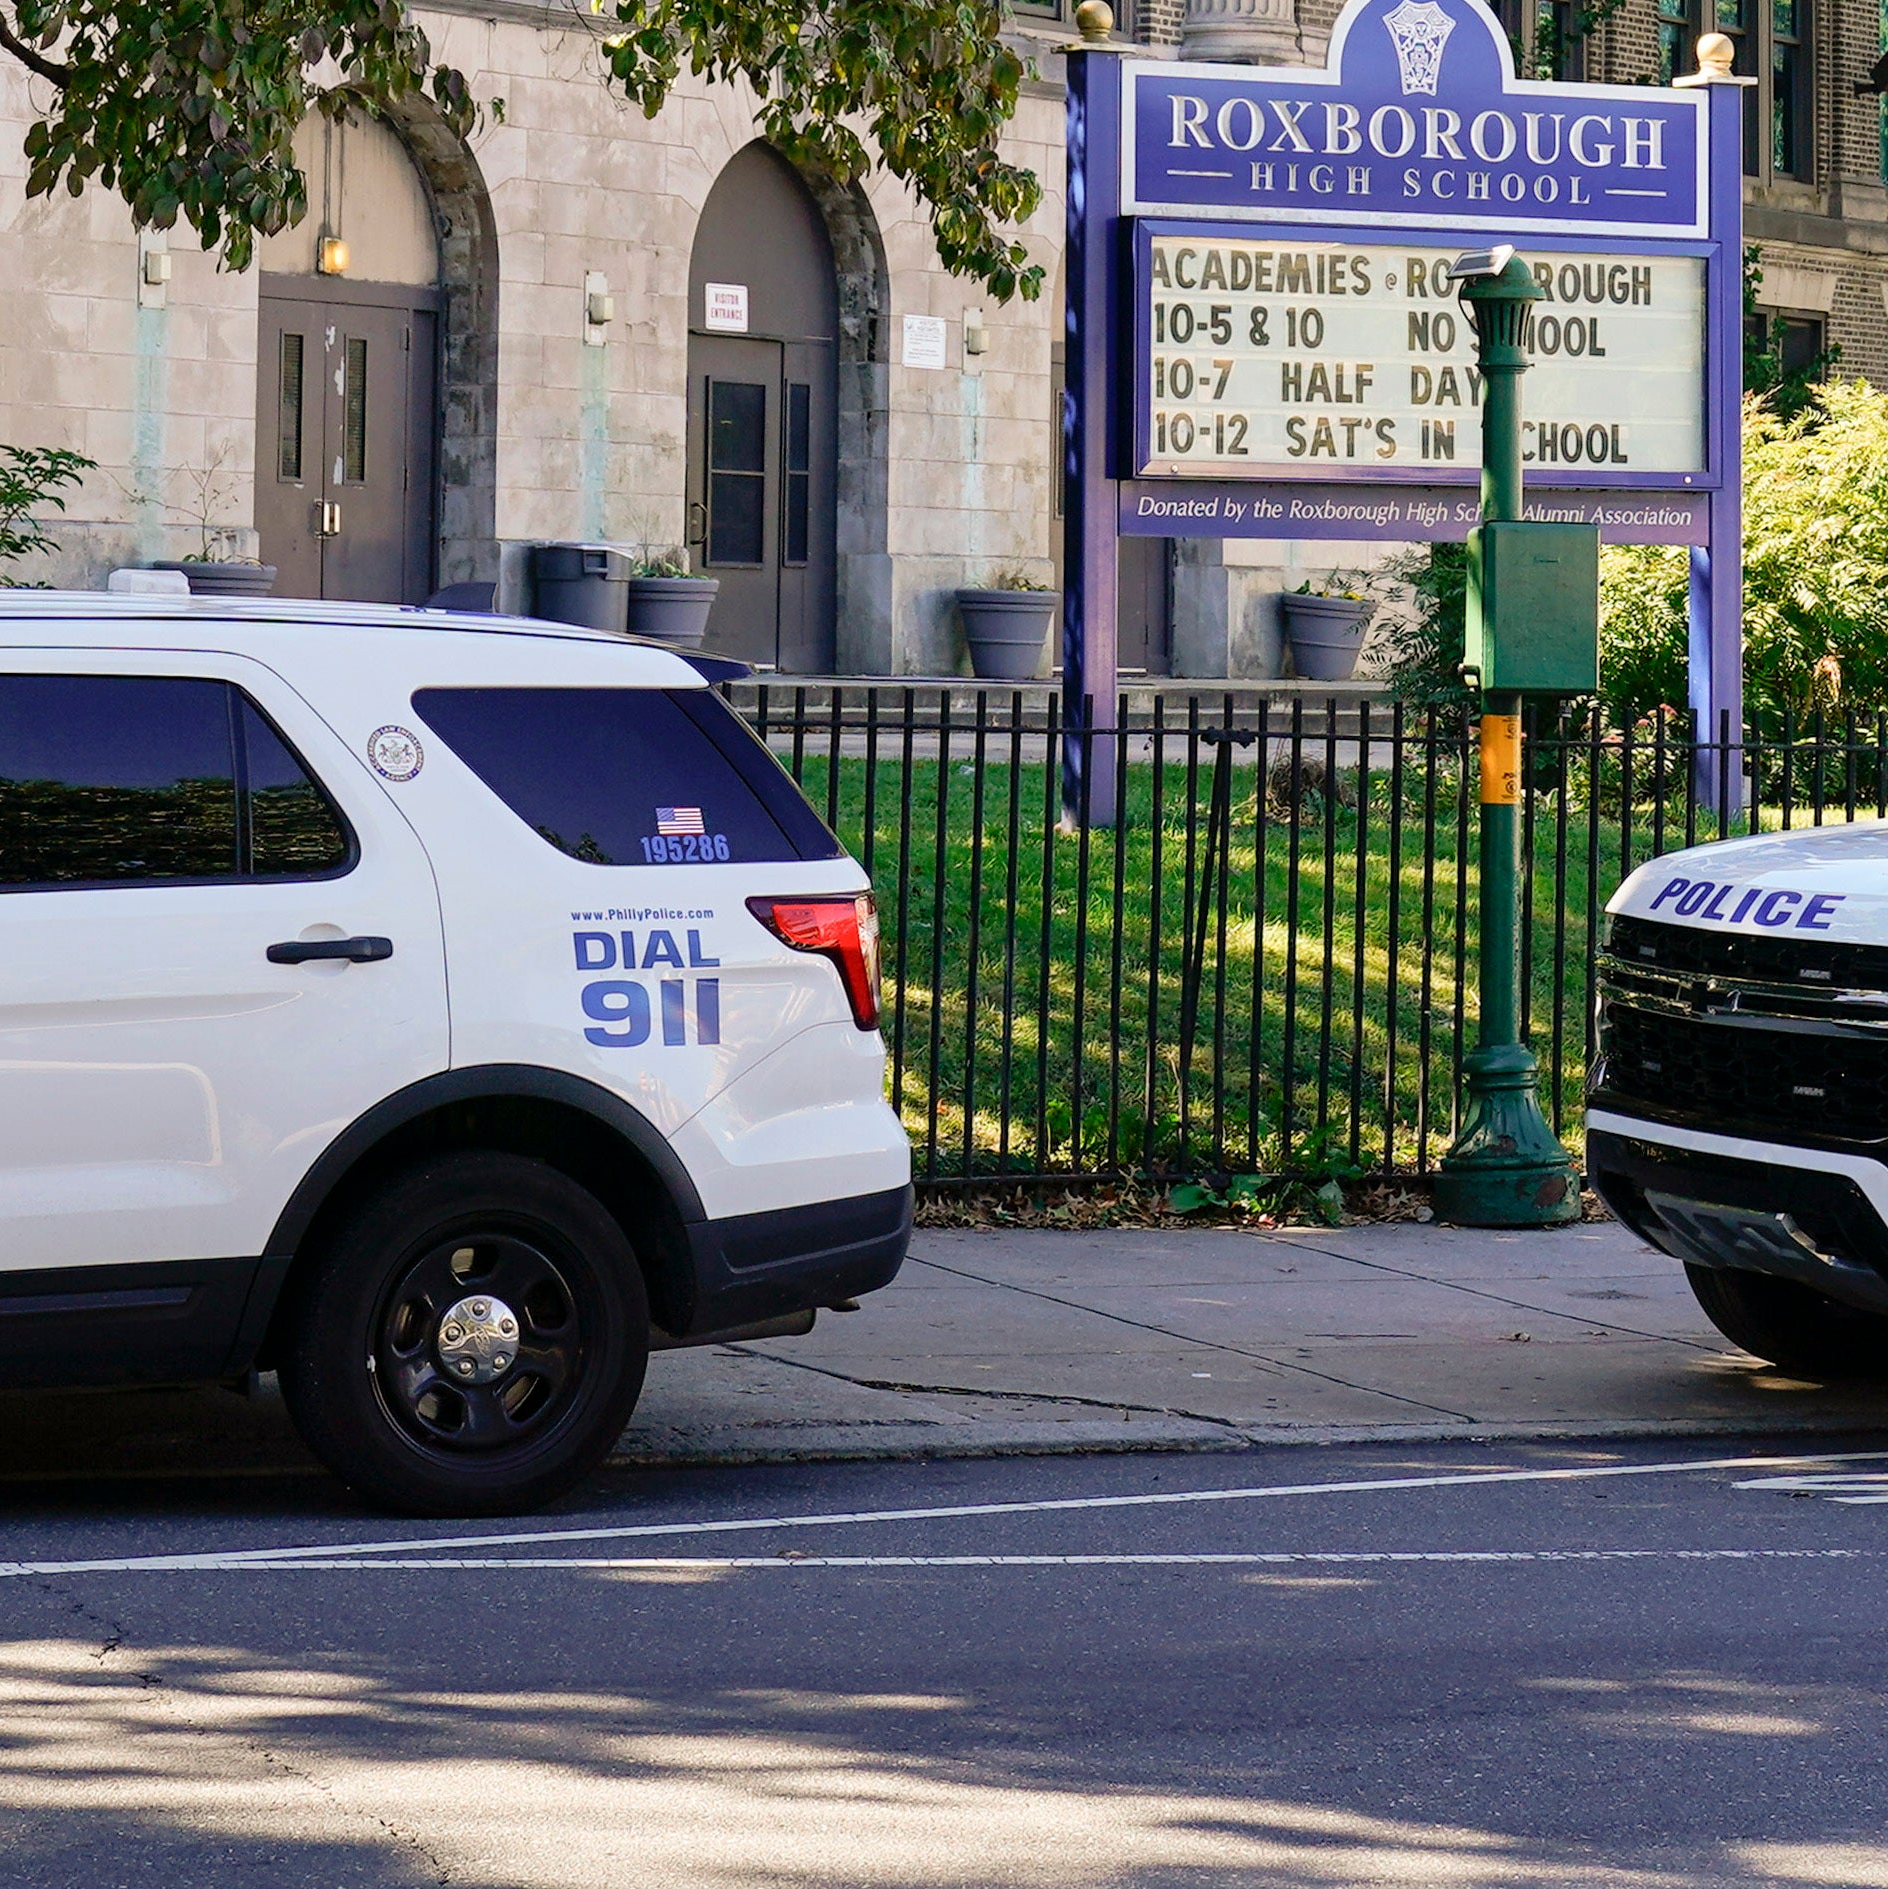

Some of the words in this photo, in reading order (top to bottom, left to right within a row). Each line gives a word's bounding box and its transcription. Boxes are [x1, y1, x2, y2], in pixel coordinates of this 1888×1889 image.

[1166, 94, 1668, 170] ROXBOROUGH
[1249, 161, 1372, 195] HIGH
[1402, 167, 1592, 205] SCHOOL
[1152, 247, 1371, 296] ACADEMIES
[1407, 257, 1651, 306] ROROUGH
[1154, 302, 1233, 346] 10-5
[1248, 305, 1271, 347] &
[1285, 306, 1325, 349] 10
[1407, 311, 1456, 353] NO
[1154, 357, 1235, 400] 10-7
[1281, 361, 1374, 404] HALF
[1410, 365, 1483, 407] DAY
[1155, 412, 1249, 455] 10-12
[1286, 415, 1398, 459] SAT'S
[1421, 419, 1455, 460] IN
[1522, 420, 1628, 464] CHOOL
[1137, 495, 1221, 518] Donated
[1223, 497, 1248, 523] by
[1252, 498, 1283, 519] the
[1289, 499, 1400, 527] Roxborough
[1406, 501, 1449, 528] High
[1523, 503, 1586, 523] Alumni
[1589, 505, 1692, 527] Association
[640, 833, 730, 863] 195286
[570, 907, 715, 922] www.PhillyPolice.com
[1649, 877, 1847, 930] POLICE
[572, 928, 721, 971] DIAL
[580, 977, 721, 1049] 911
